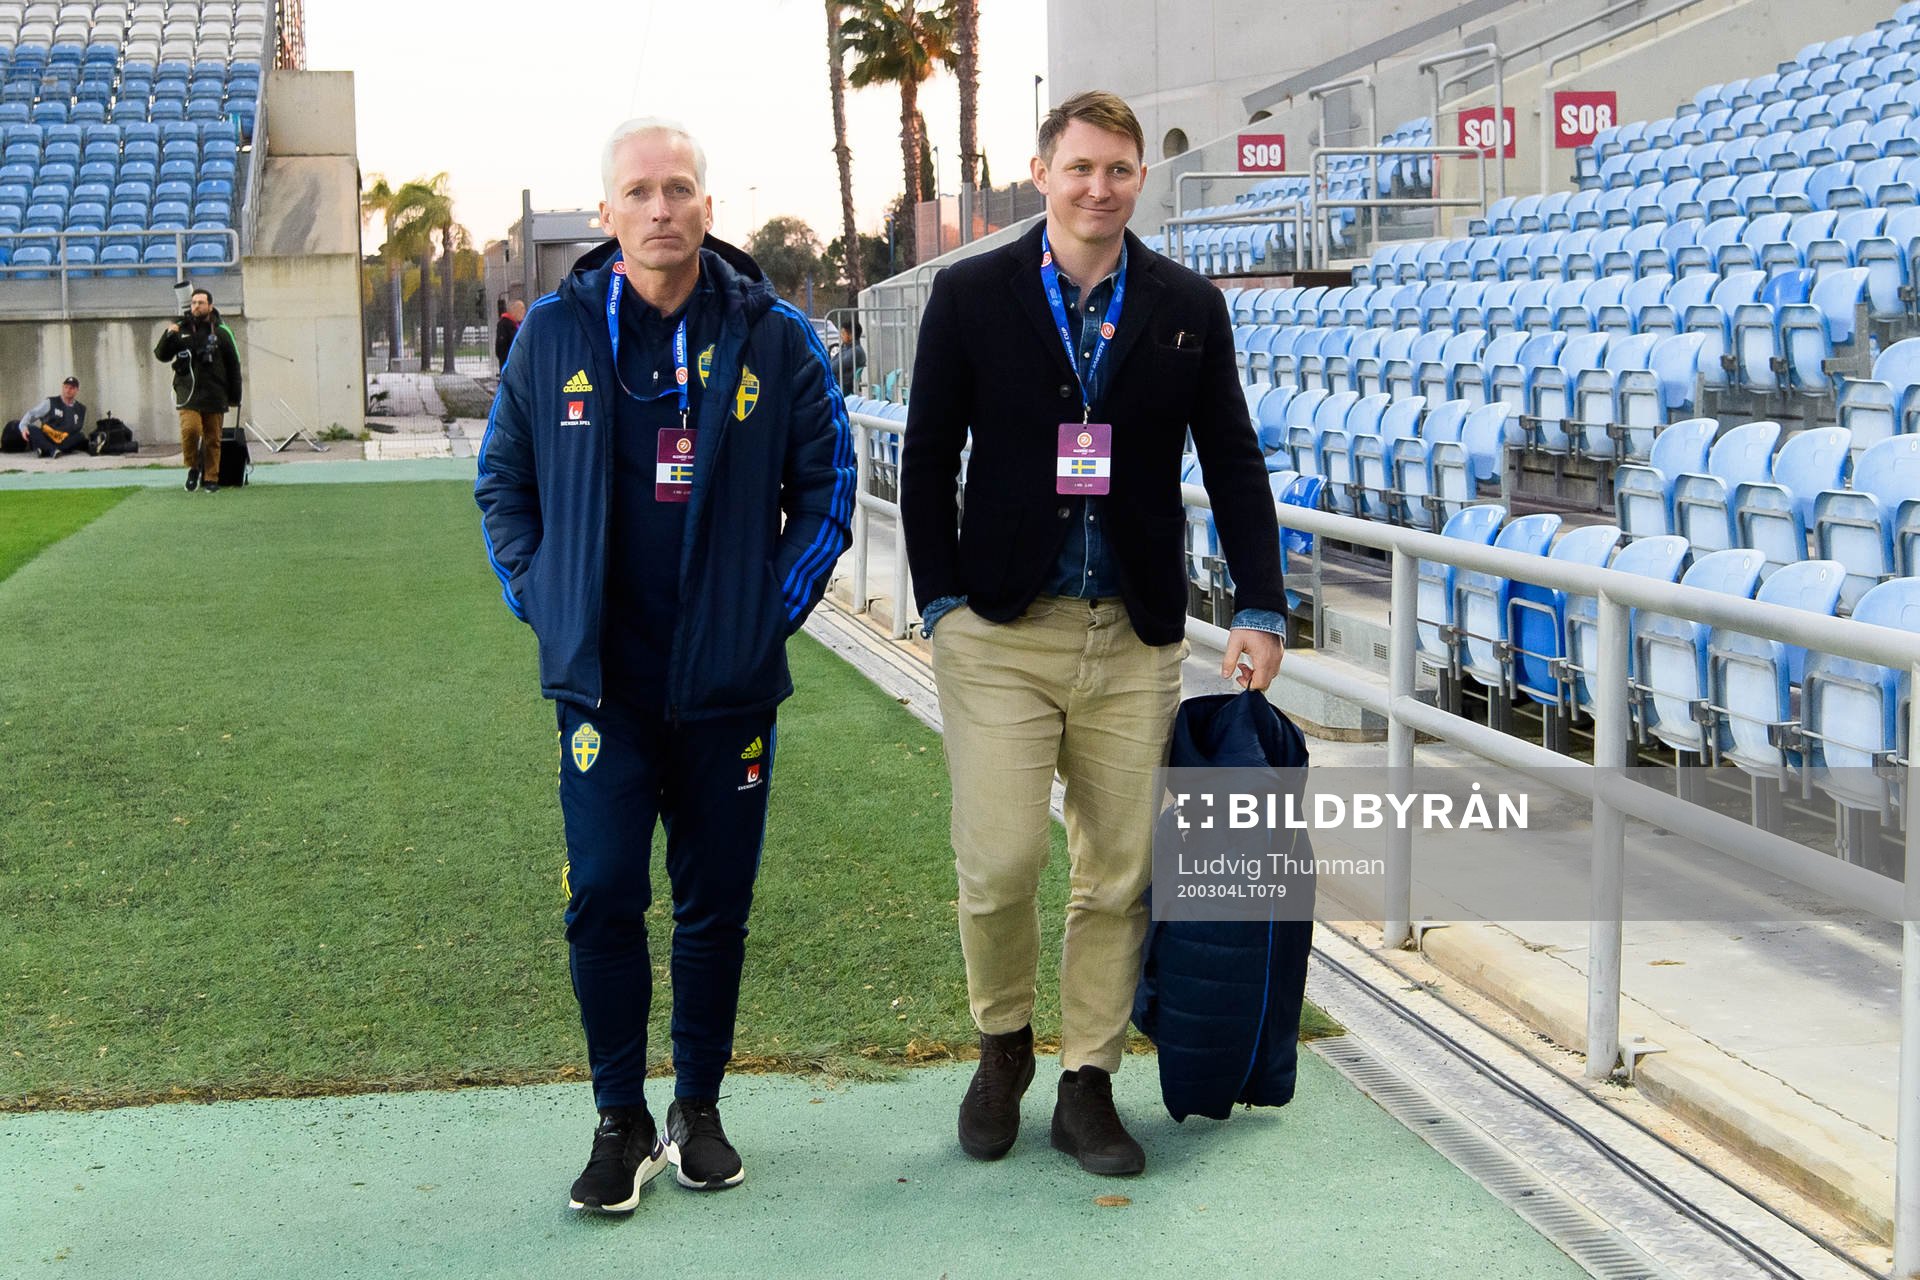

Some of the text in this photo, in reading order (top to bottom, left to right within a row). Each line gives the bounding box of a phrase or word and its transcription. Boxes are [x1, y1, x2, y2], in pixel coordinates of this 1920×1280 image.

[1561, 104, 1612, 135] S08
[1242, 144, 1281, 167] S09
[609, 302, 617, 315] CUP
[676, 332, 684, 363] ALGARVE
[563, 384, 593, 393] adidas
